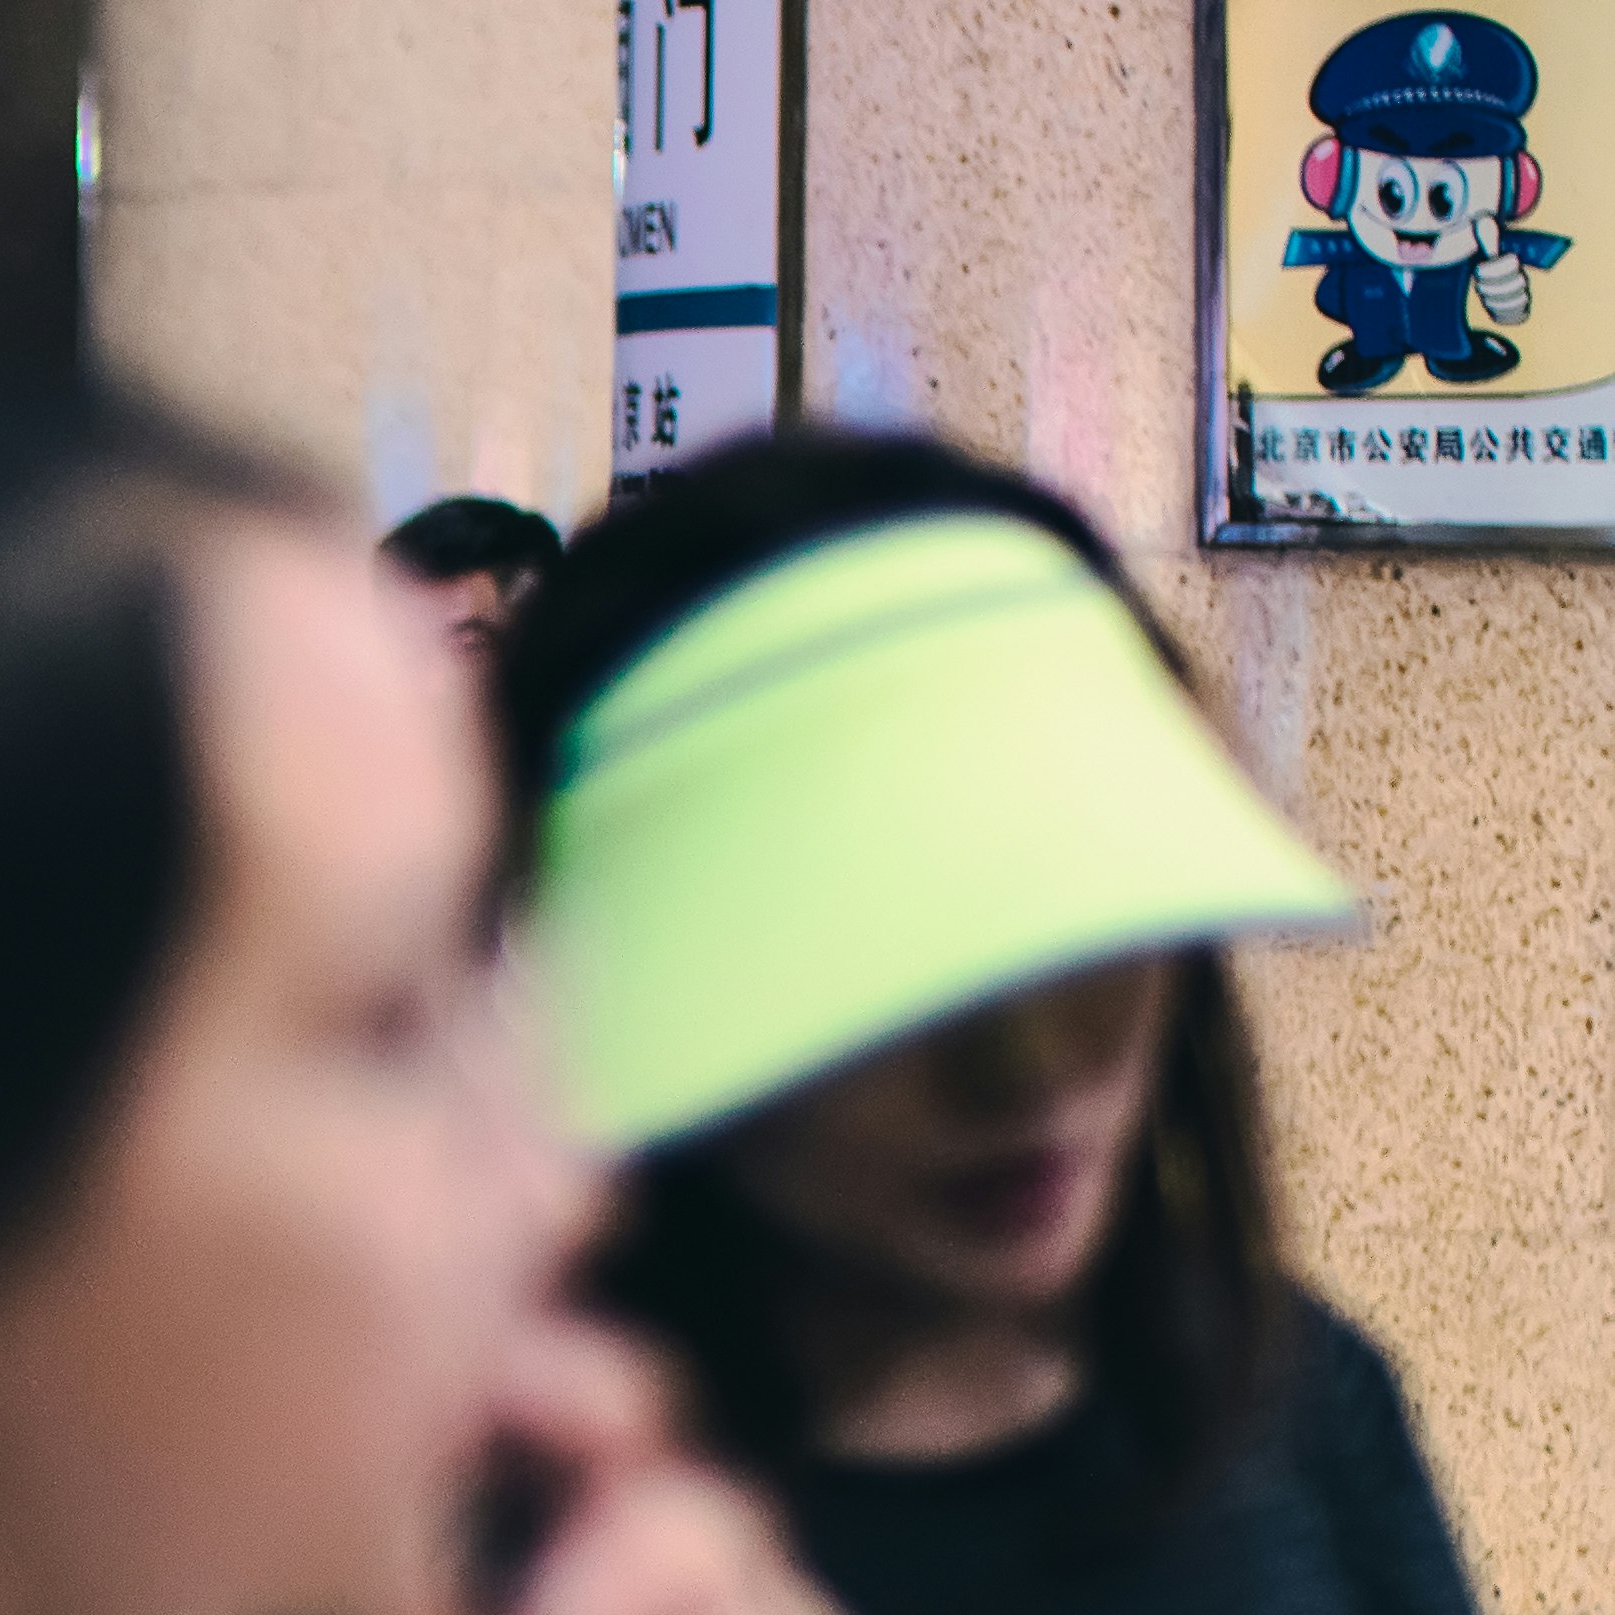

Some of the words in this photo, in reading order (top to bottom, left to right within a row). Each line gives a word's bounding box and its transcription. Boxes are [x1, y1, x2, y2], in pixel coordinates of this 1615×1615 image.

[619, 0, 715, 152] 门
[1257, 425, 1615, 464] 北京市公安局公共交通
